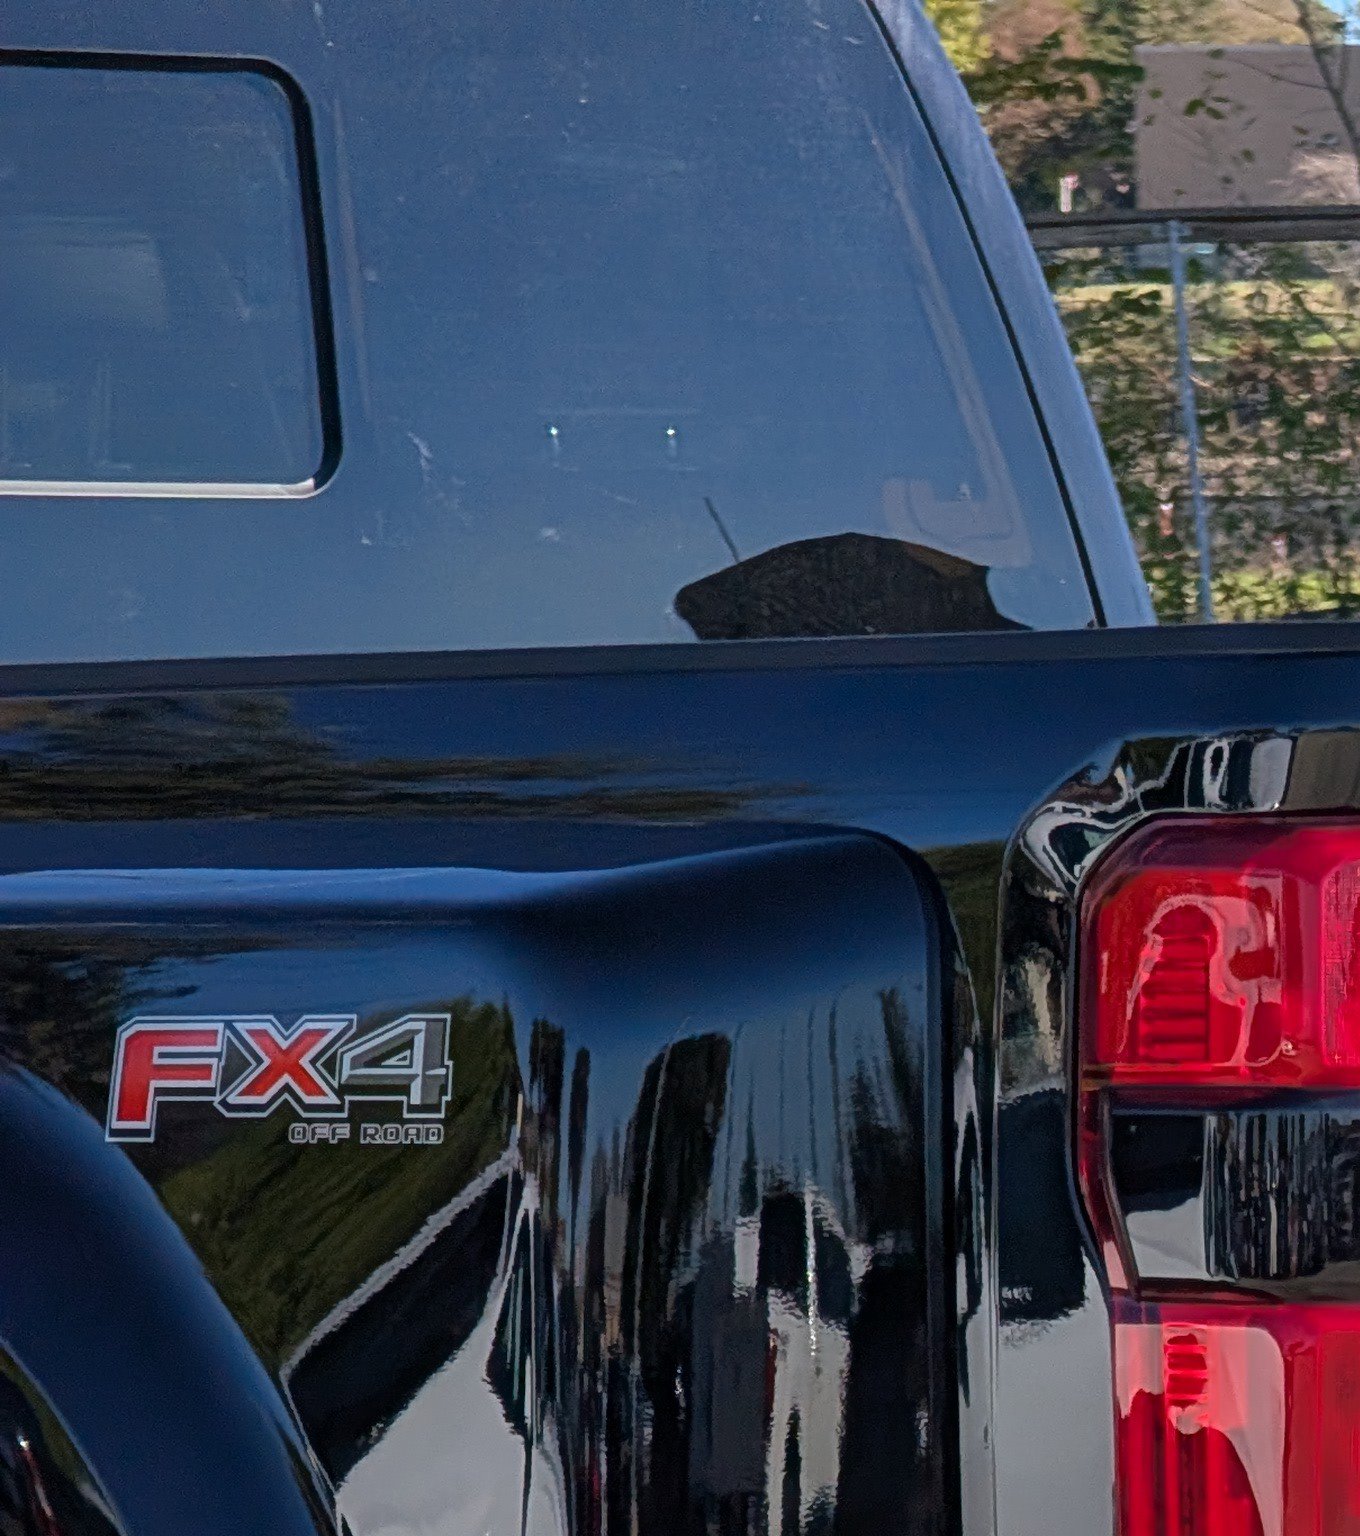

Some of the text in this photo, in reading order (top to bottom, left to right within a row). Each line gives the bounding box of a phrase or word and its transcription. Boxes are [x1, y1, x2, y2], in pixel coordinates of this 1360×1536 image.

[105, 1013, 452, 1143] FX4
[288, 1122, 445, 1144] OFF ROAD
